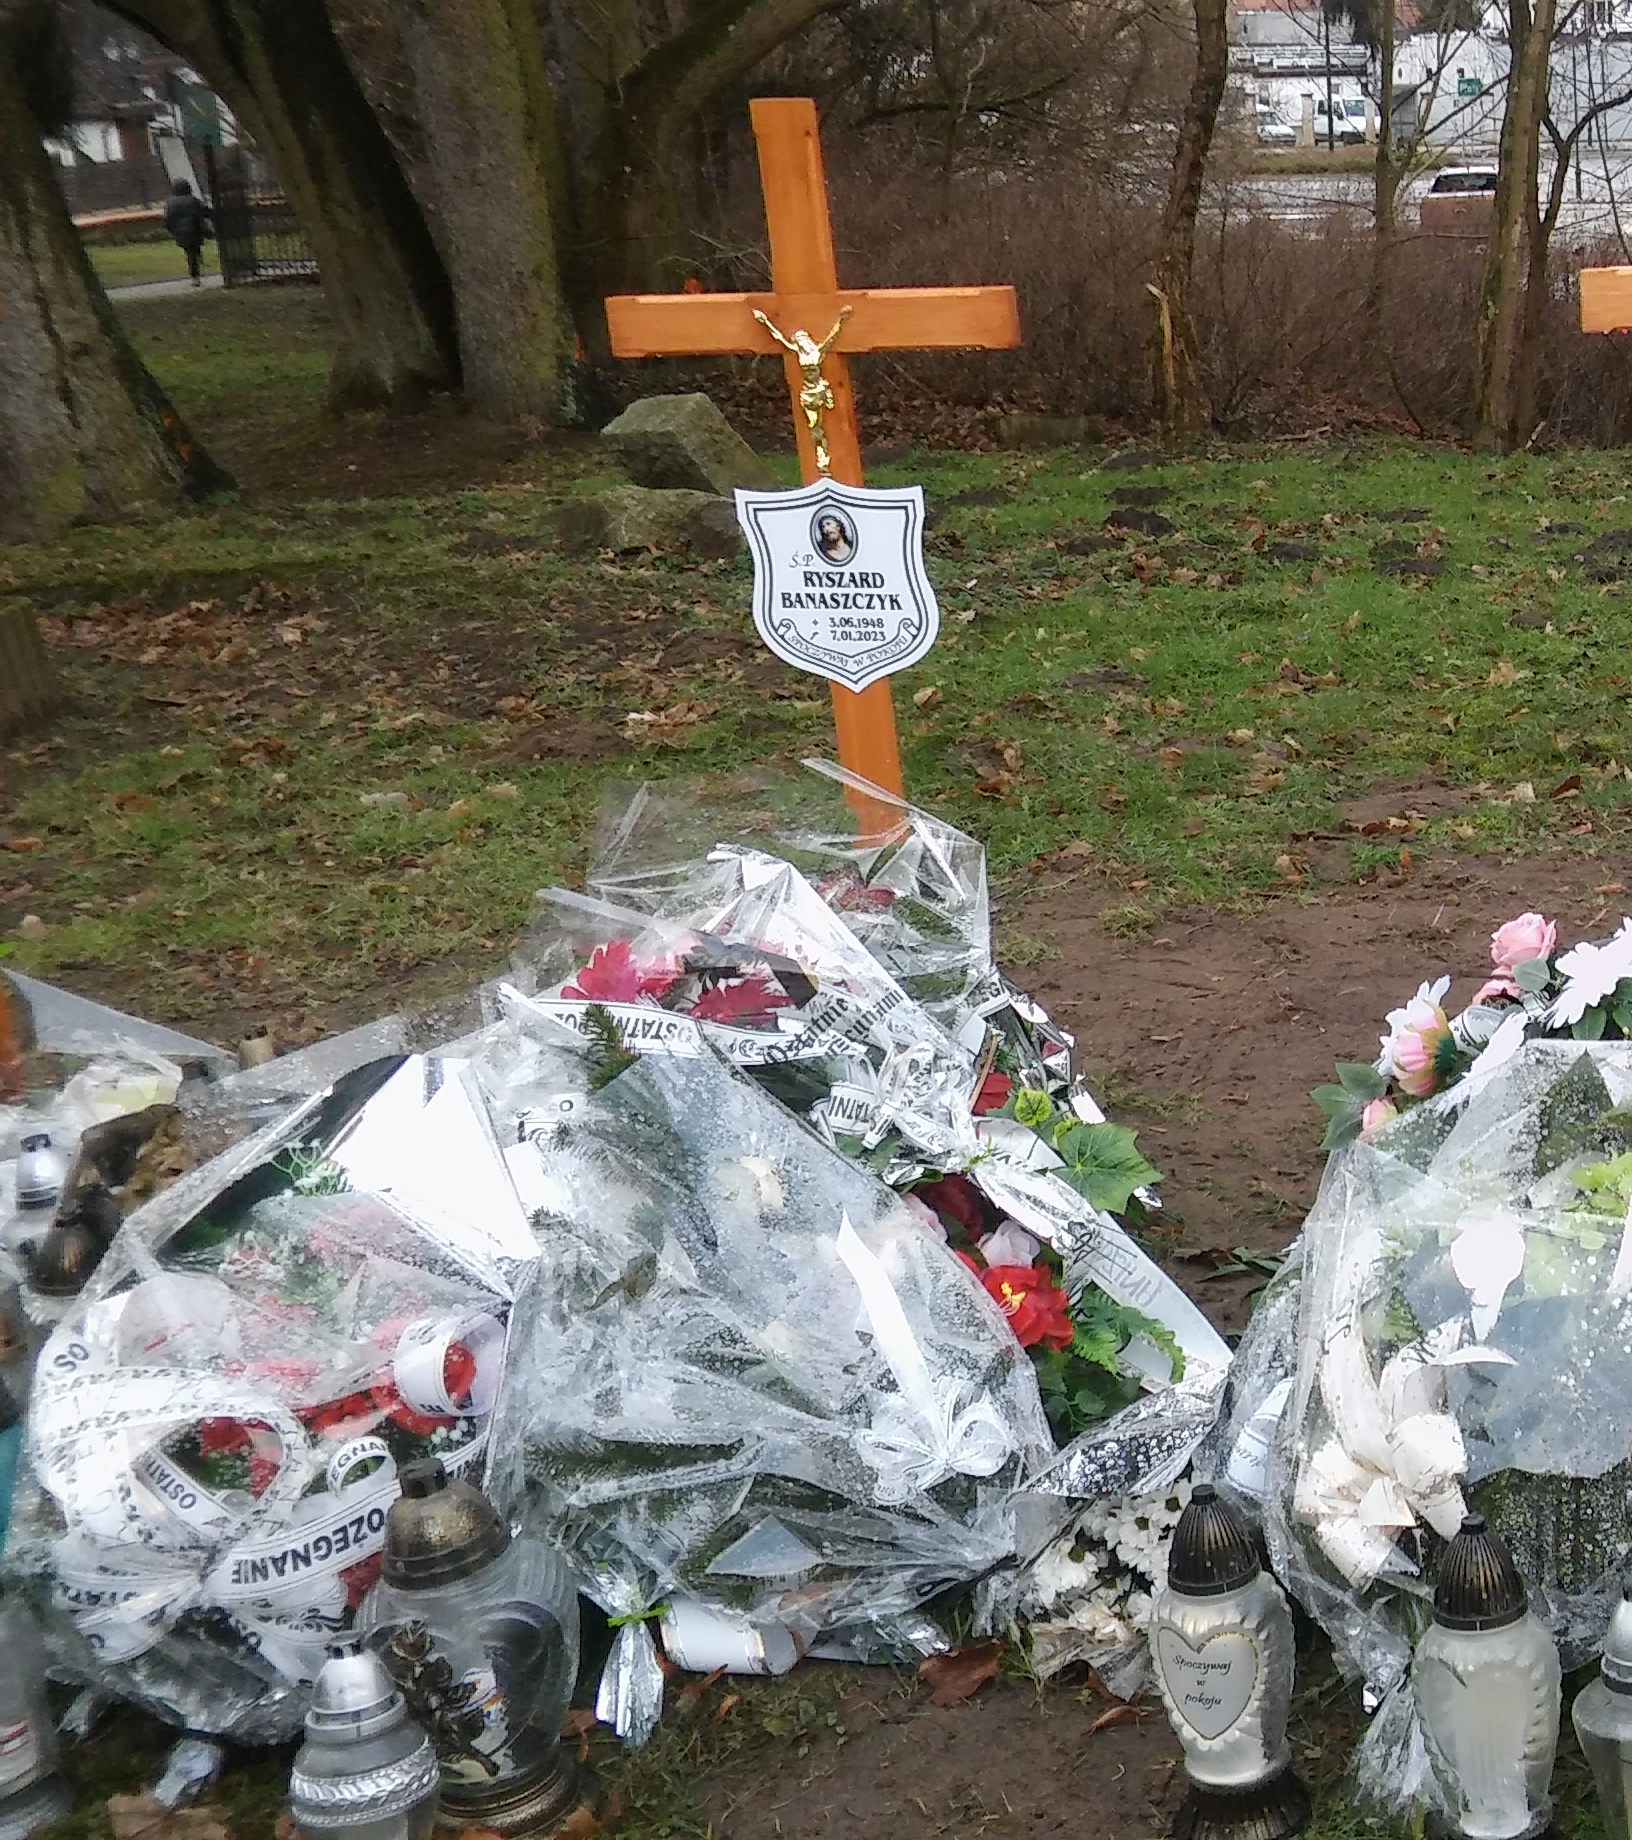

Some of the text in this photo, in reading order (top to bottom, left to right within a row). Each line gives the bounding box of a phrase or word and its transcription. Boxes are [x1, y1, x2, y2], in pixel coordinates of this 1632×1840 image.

[803, 571, 885, 589] RYSZARD
[781, 592, 903, 610] BANASZCZYK
[829, 617, 885, 629] 3.06.1948
[830, 630, 887, 642] 7.01.2023
[231, 1507, 386, 1585] OŻEGNANIE
[1172, 1655, 1233, 1676] Spoczywaj
[1196, 1679, 1206, 1687] w
[1184, 1692, 1223, 1711] pokoju
